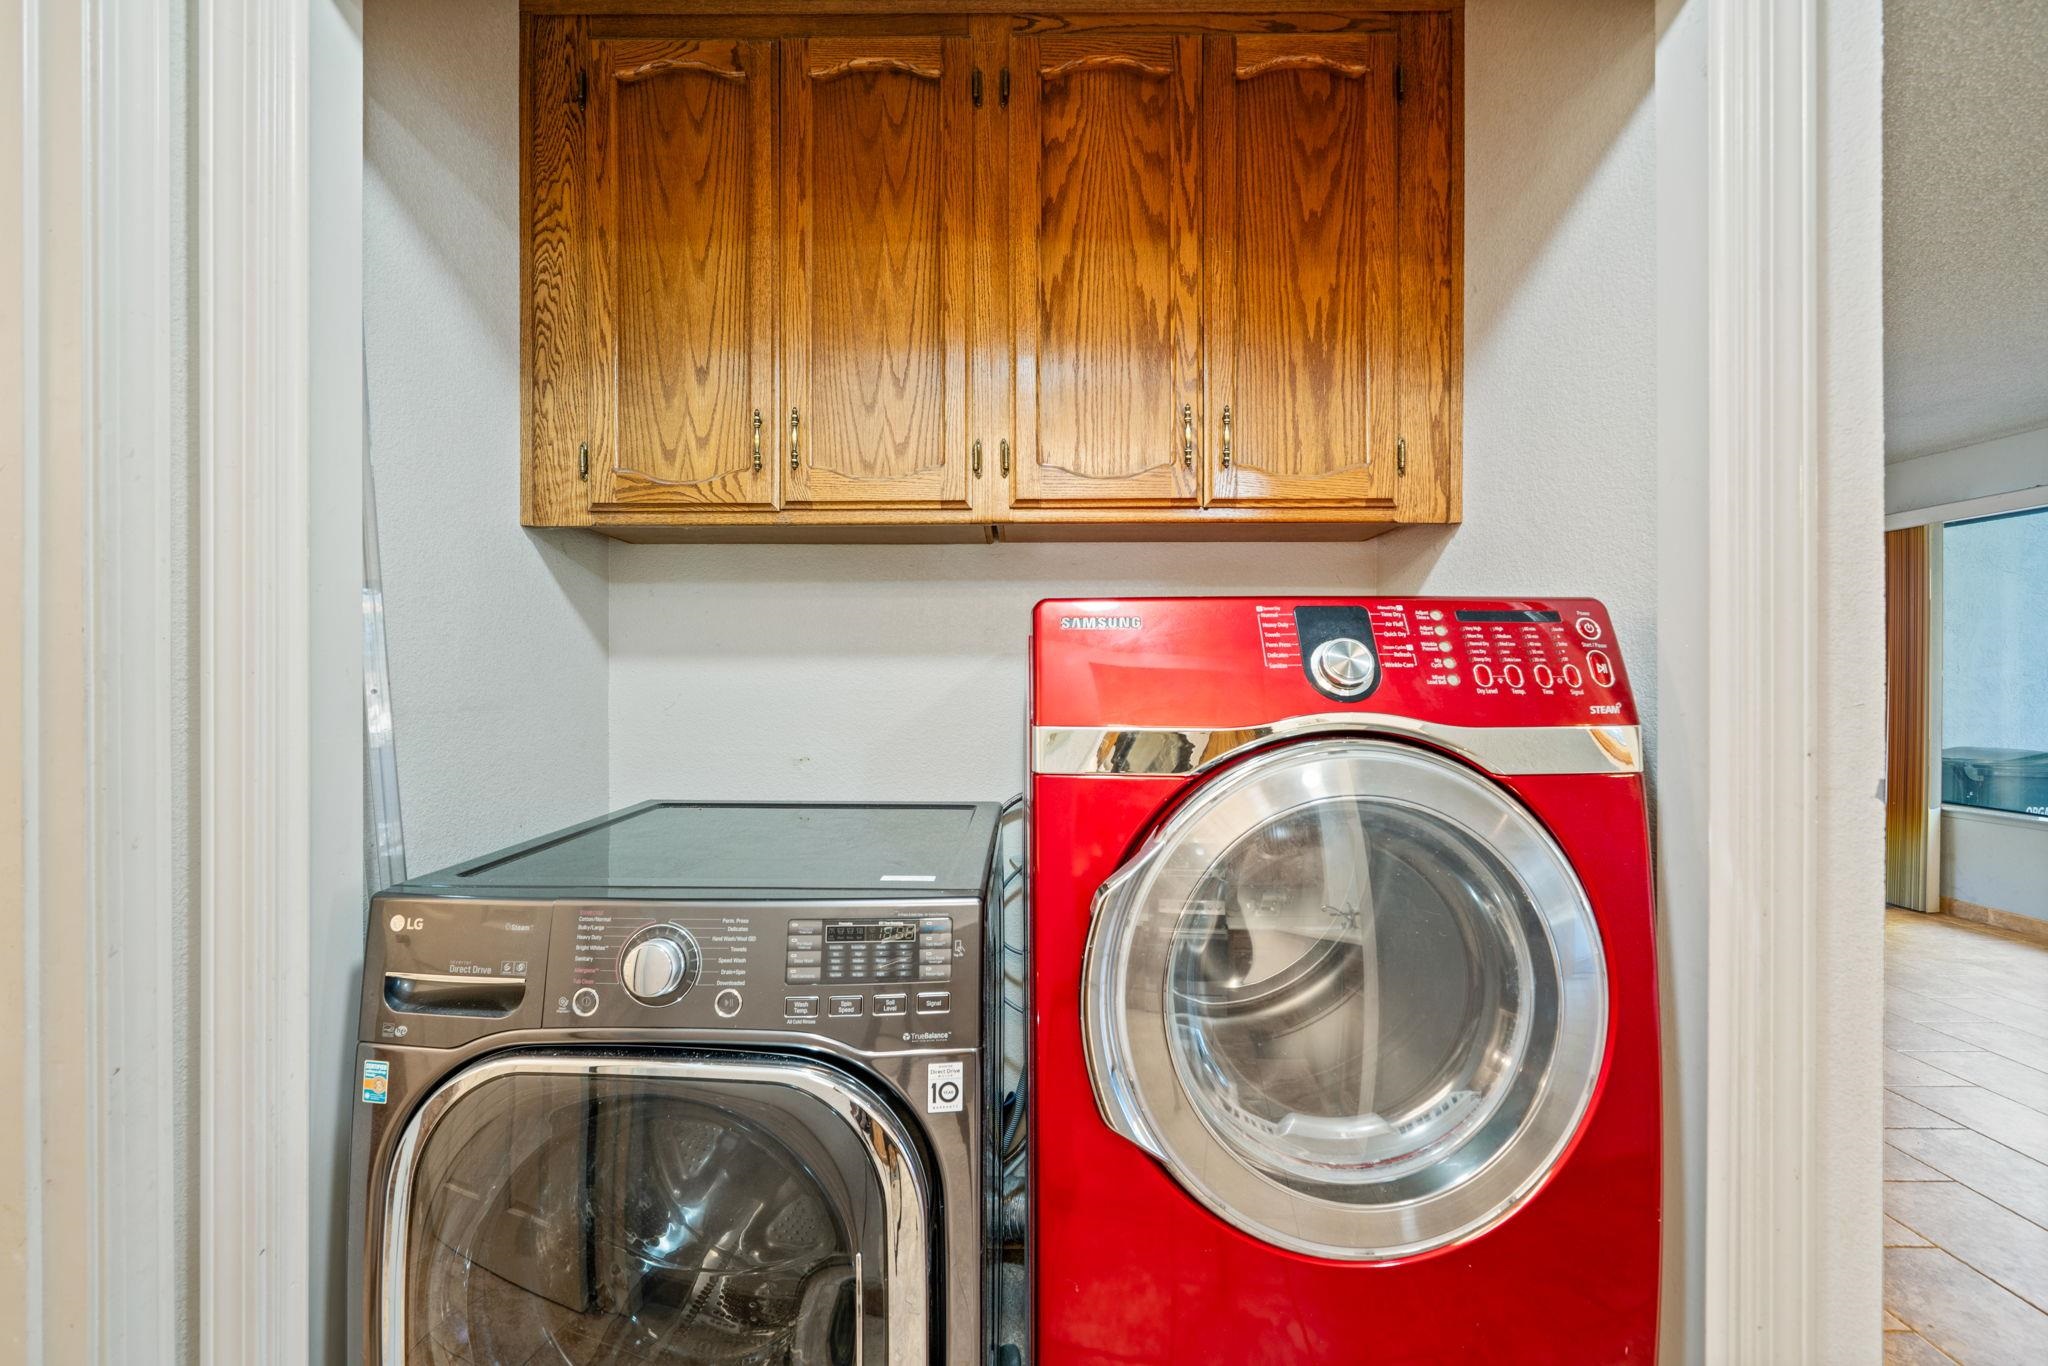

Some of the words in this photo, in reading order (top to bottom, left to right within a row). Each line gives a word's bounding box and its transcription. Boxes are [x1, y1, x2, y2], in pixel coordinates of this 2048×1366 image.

[1060, 617, 1141, 629] SAMSUNG
[1590, 705, 1620, 714] STEAM
[406, 918, 424, 930] LG
[449, 965, 471, 974] Direct
[472, 966, 492, 974] Drive
[931, 1081, 959, 1103] 10
